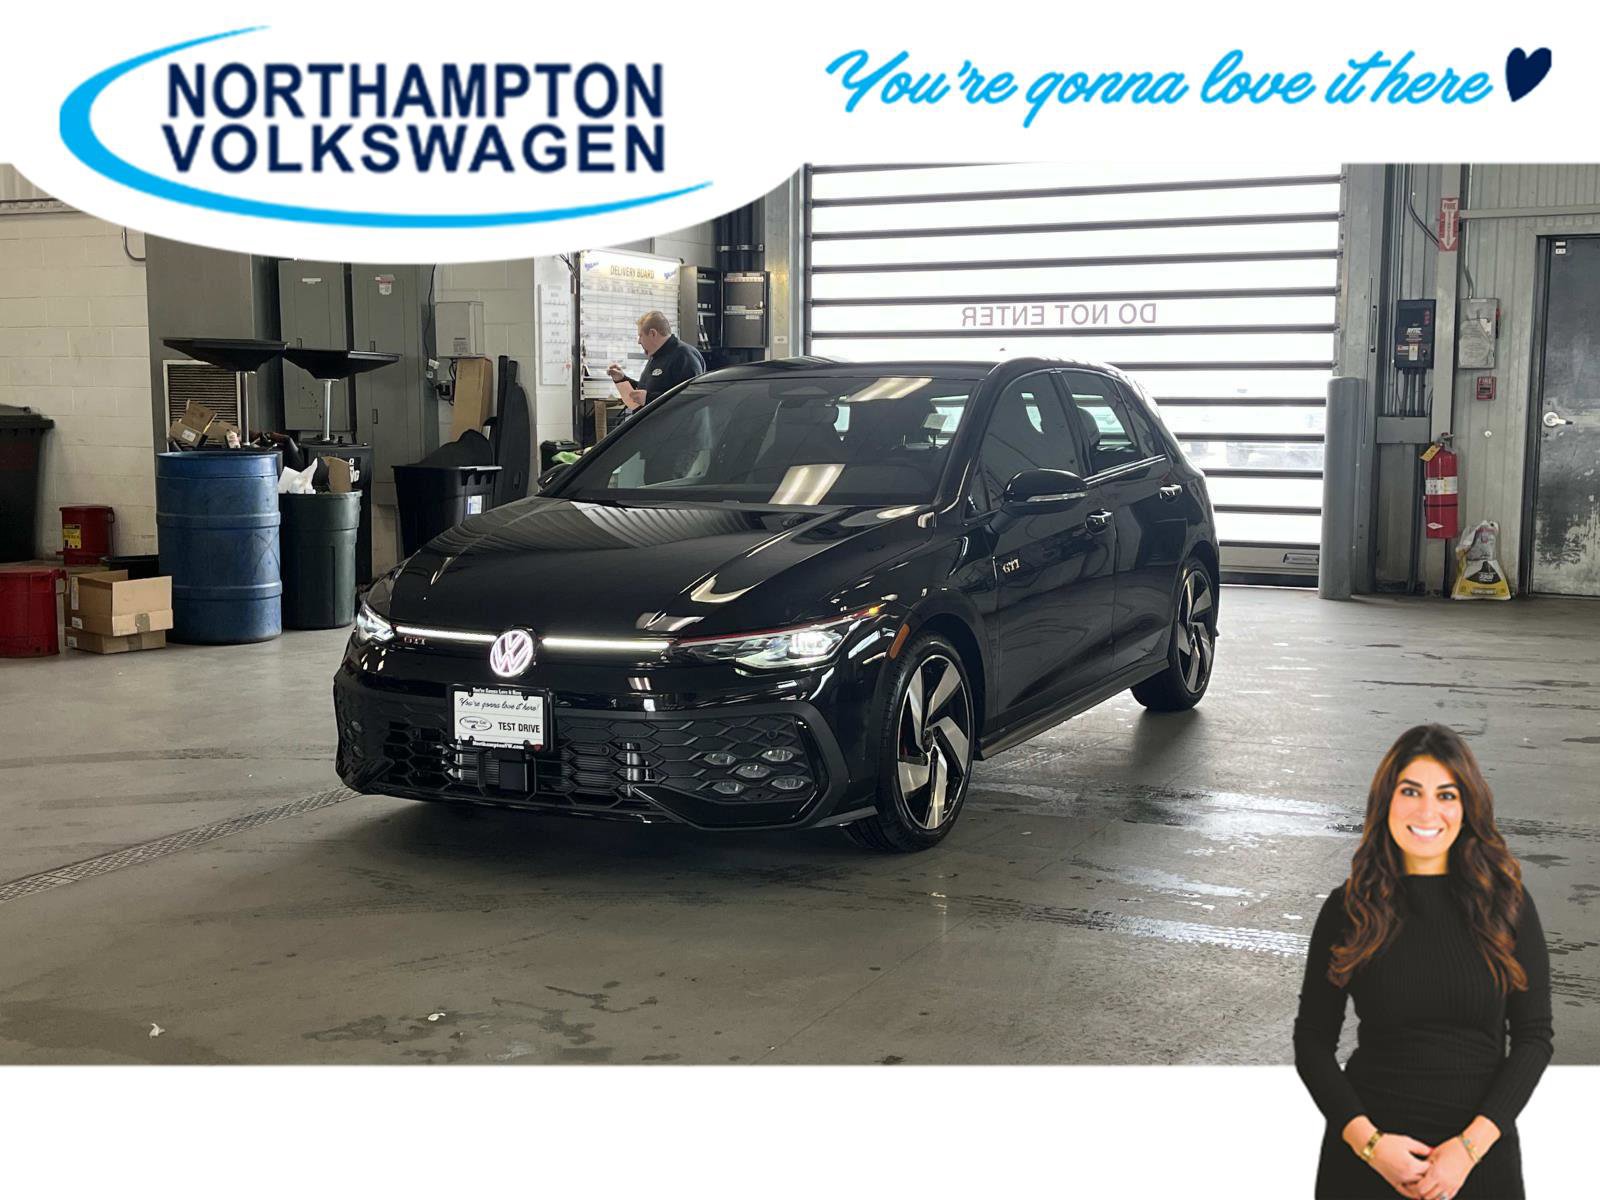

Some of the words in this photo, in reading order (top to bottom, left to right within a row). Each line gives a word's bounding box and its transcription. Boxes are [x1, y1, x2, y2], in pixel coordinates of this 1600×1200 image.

[610, 264, 636, 278] DELIVERY
[637, 268, 655, 280] BOARD
[1002, 558, 1020, 573] GTI
[481, 701, 500, 710] gonna
[501, 701, 515, 710] love
[498, 722, 516, 731] TEST
[518, 724, 540, 733] DRIVE
